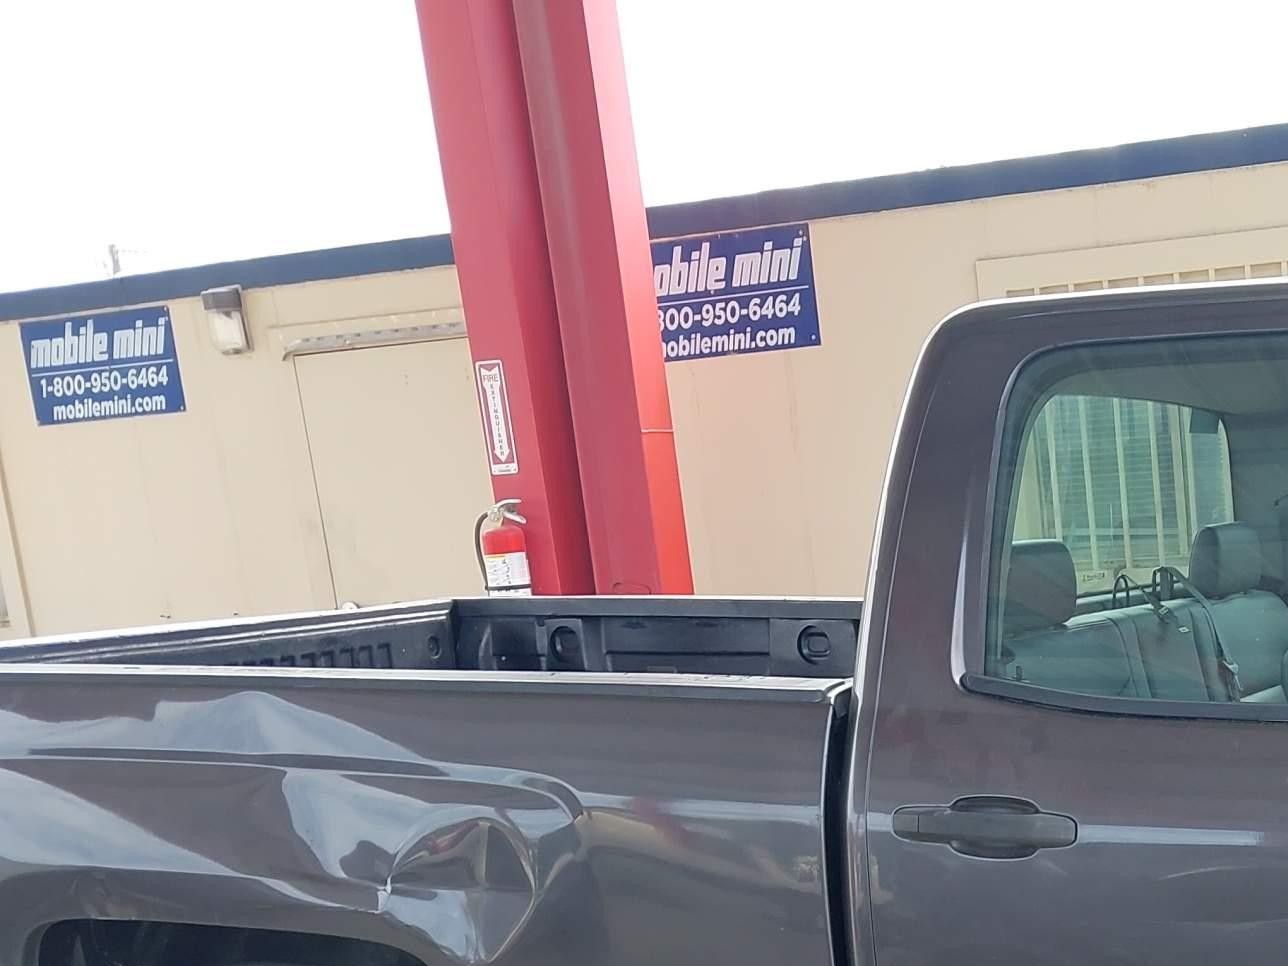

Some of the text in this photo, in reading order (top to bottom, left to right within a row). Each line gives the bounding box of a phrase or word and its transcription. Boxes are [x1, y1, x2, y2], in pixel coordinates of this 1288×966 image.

[654, 238, 802, 297] obile mini
[31, 317, 166, 368] mobile mini
[662, 326, 795, 358] obilemini.com
[40, 366, 168, 398] 1-800-950-6464
[482, 374, 499, 383] FIRE
[53, 394, 165, 421] mobilemini.com
[490, 383, 505, 456] EXTINGUISHER
